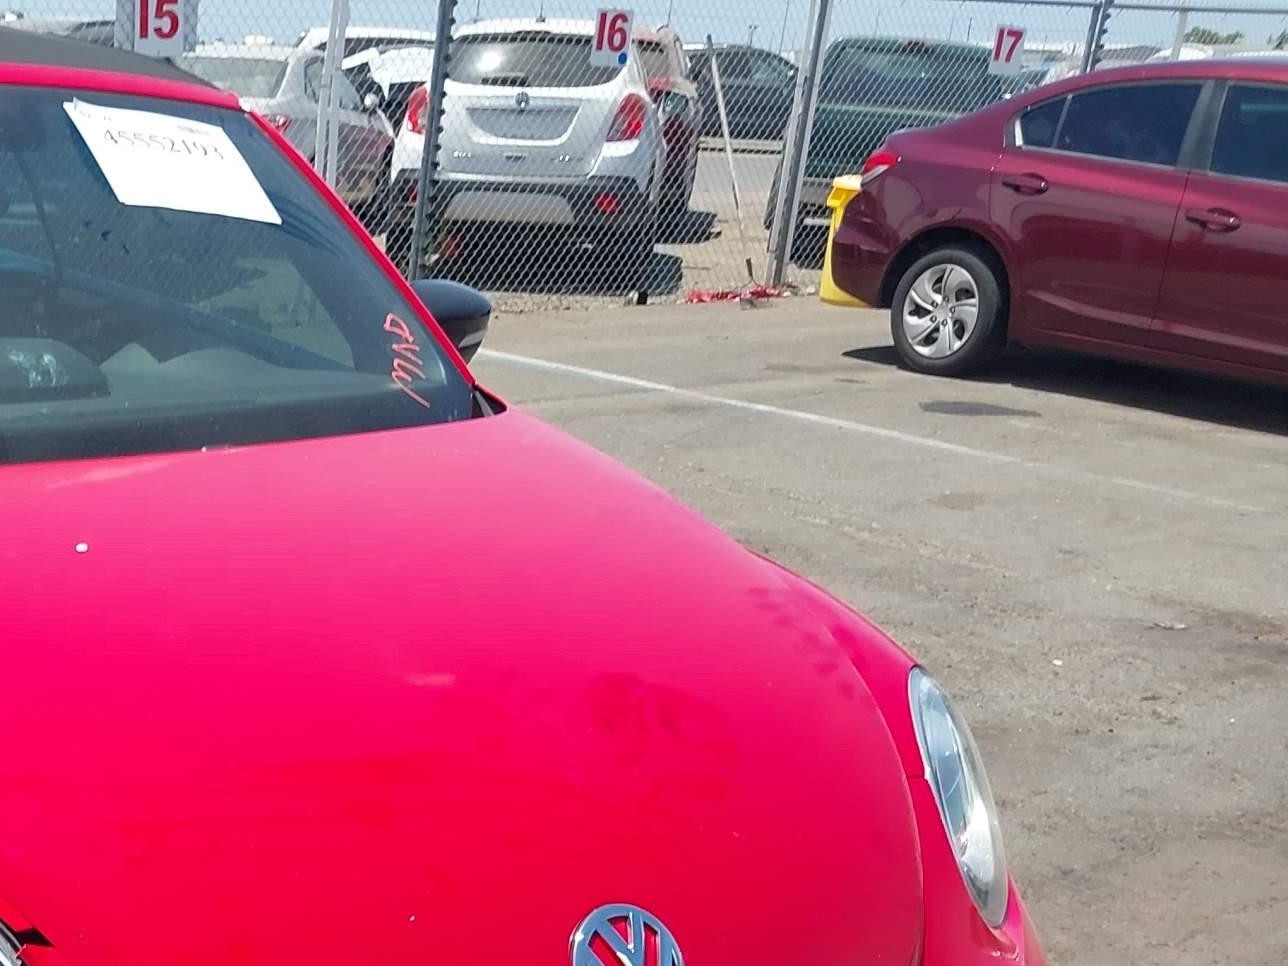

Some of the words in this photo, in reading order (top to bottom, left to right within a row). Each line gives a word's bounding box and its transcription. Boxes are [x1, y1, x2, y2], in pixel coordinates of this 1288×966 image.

[139, 0, 180, 39] 15
[595, 12, 629, 52] 16
[993, 28, 1024, 62] 17
